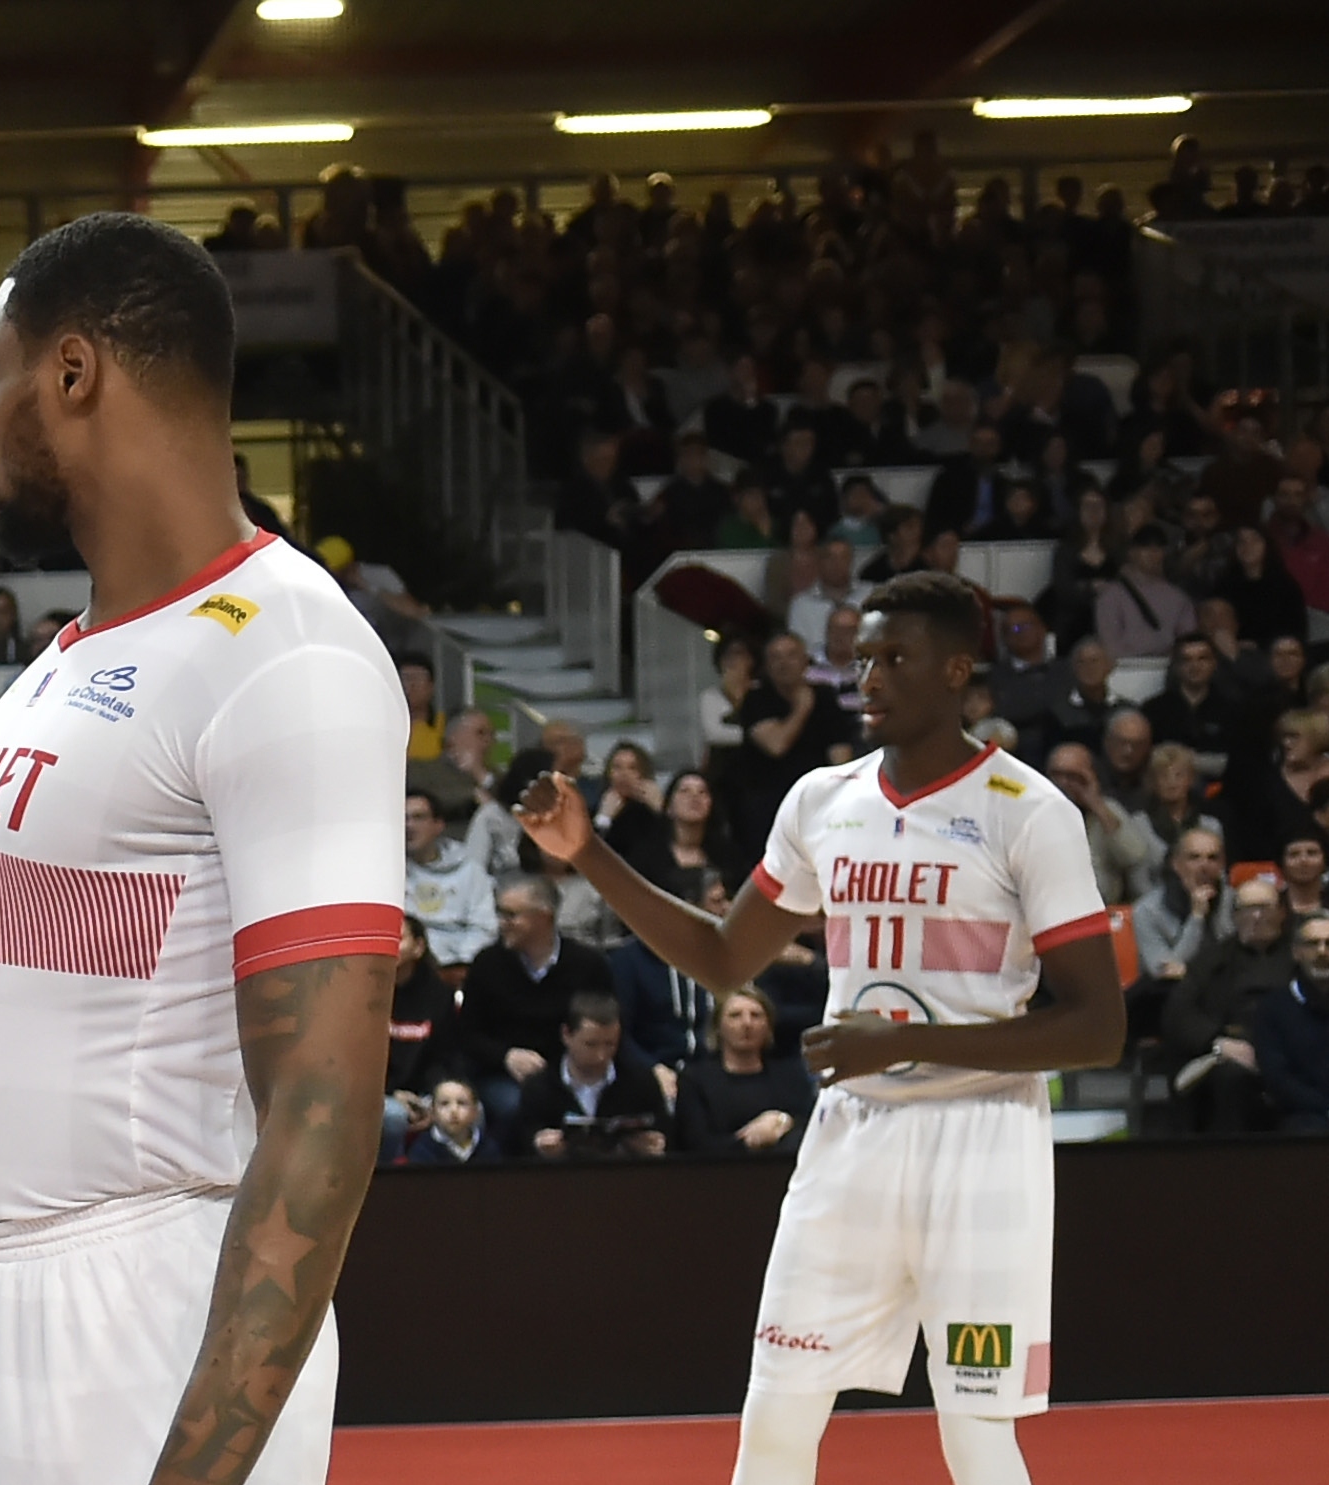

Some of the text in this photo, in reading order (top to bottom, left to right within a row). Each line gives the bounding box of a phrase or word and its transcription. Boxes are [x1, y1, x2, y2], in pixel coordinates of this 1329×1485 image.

[79, 686, 135, 718] Choletais
[830, 854, 959, 906] CHOLET
[865, 914, 905, 970] 11
